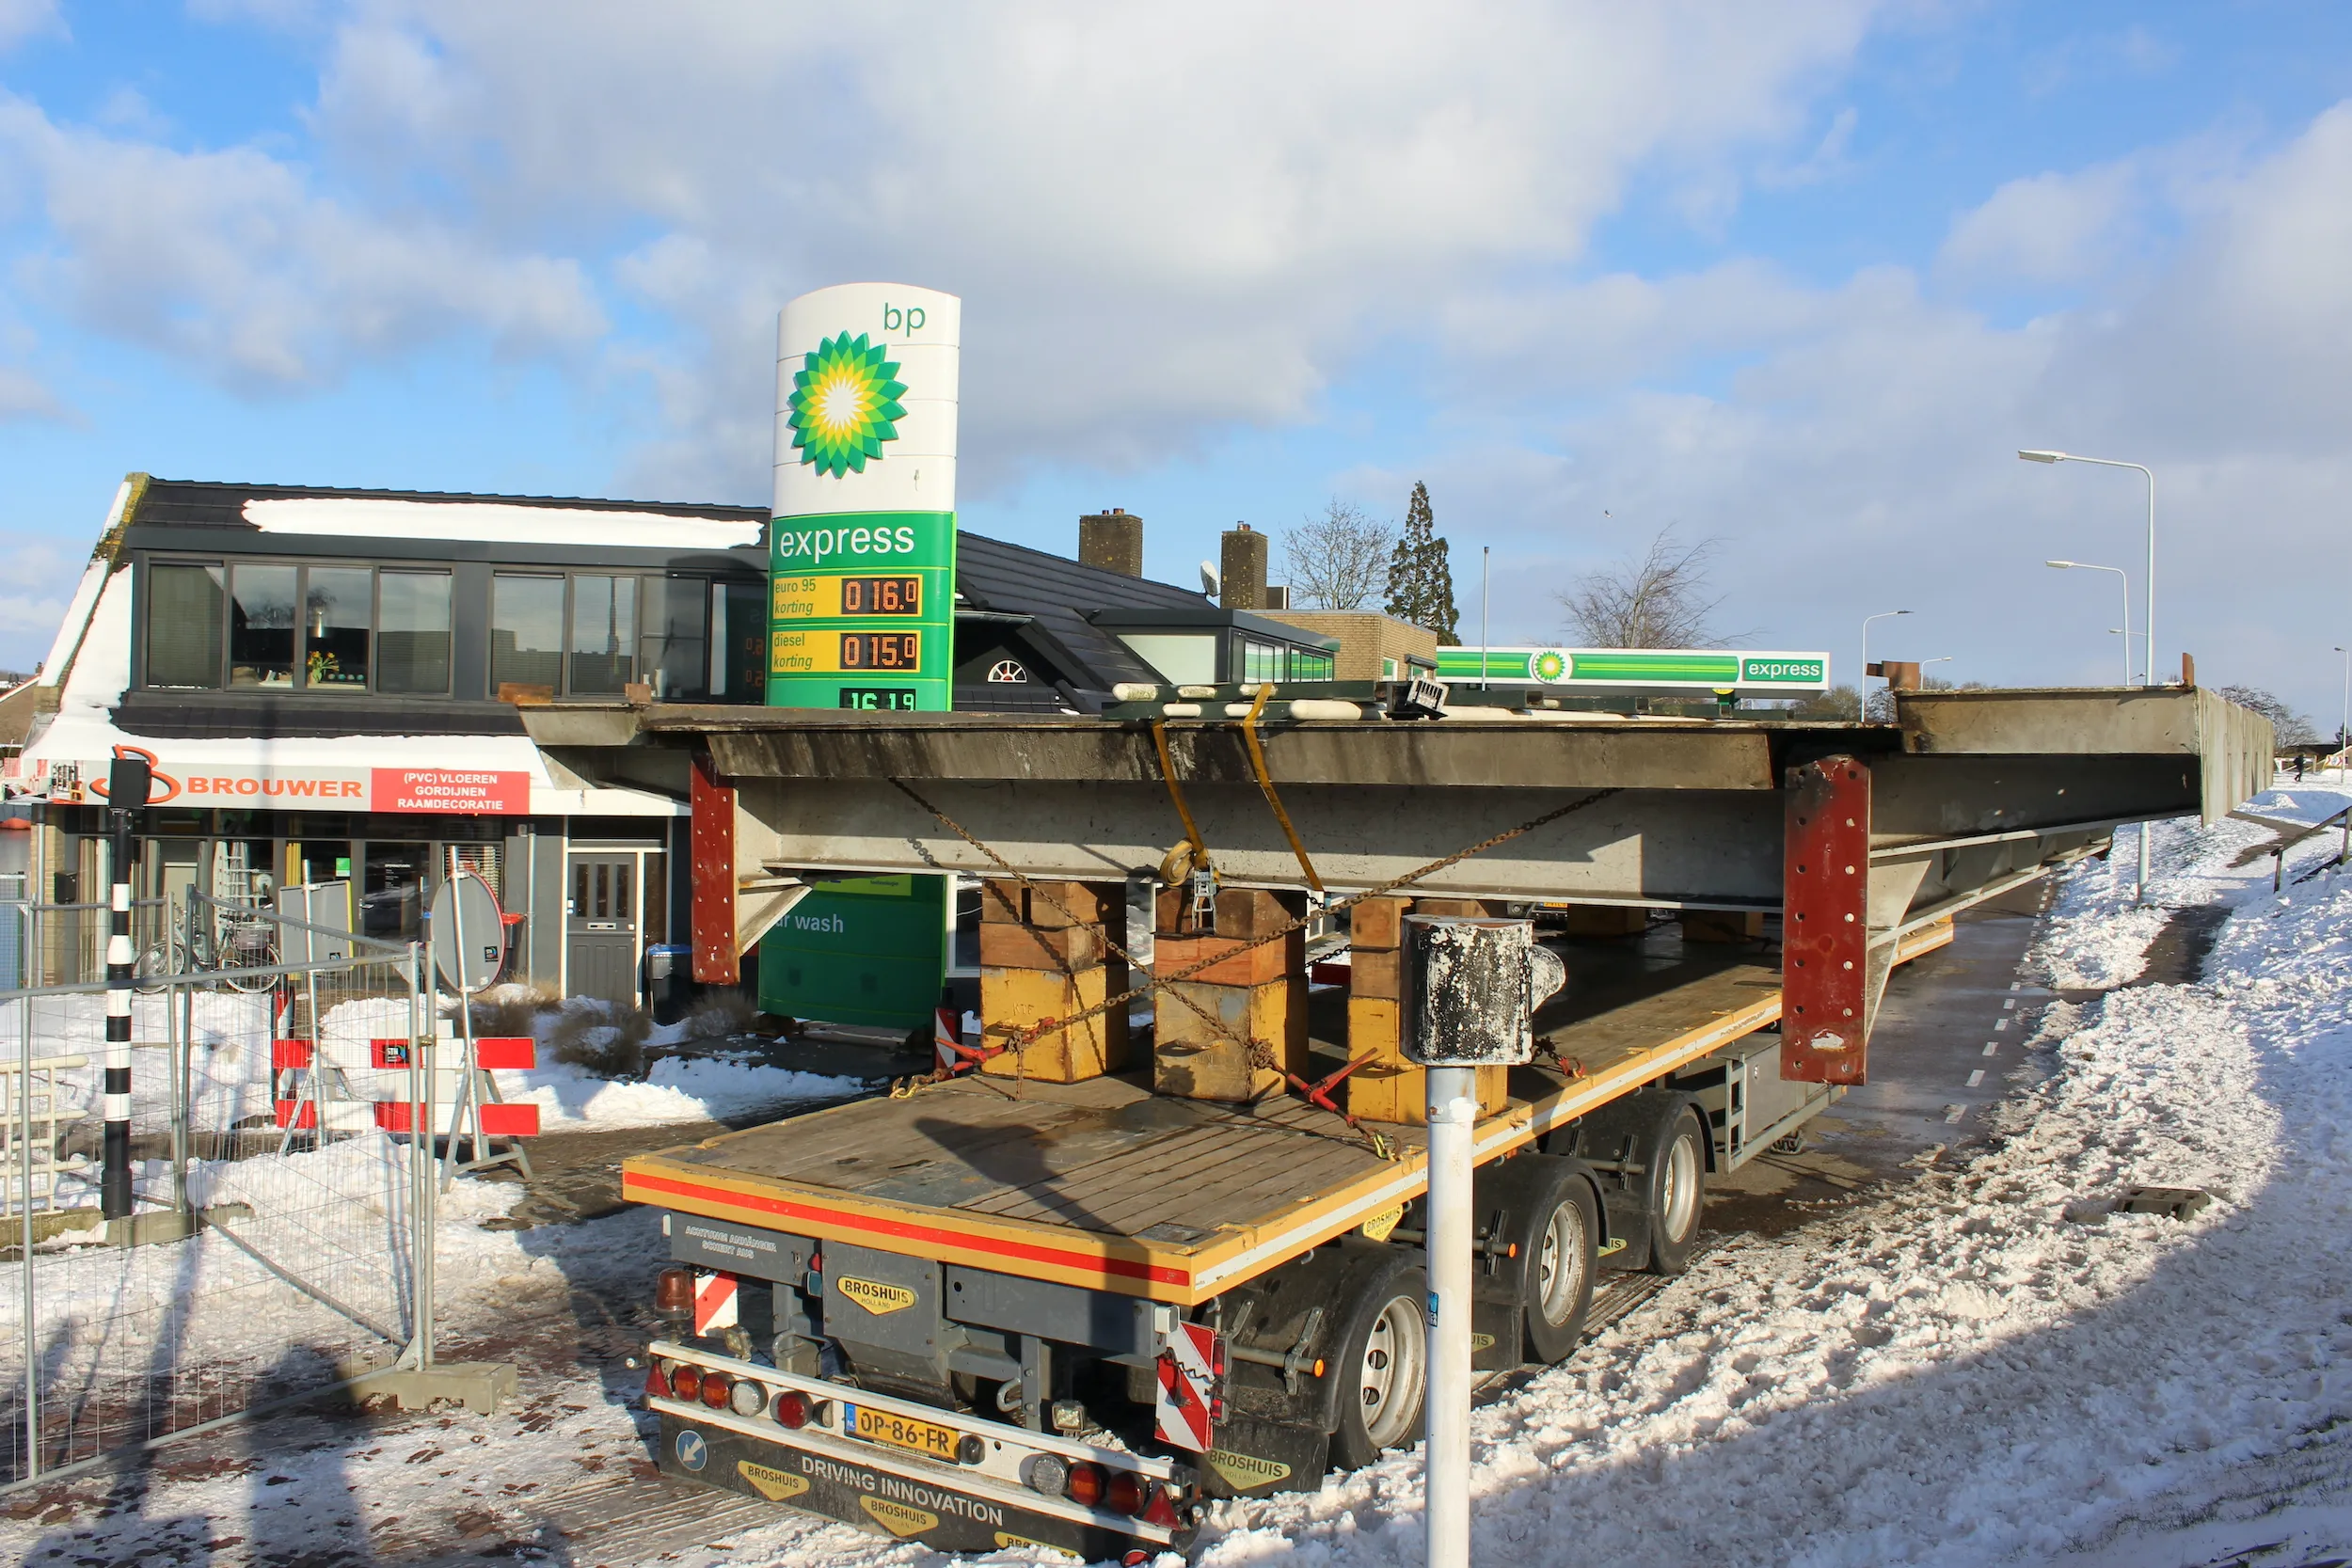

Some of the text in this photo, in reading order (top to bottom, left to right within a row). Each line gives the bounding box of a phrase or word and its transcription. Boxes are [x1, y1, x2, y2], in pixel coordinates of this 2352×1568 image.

[883, 302, 926, 338] bp
[780, 526, 914, 564] express
[775, 578, 816, 594] euro 95
[774, 599, 814, 615] korting
[773, 633, 805, 647] diesel
[773, 654, 813, 670] korting
[1748, 663, 1820, 678] express
[404, 772, 498, 784] (PVC) VLOEREN
[187, 777, 363, 798] BROUWER
[415, 785, 486, 797] GORDIJNEN
[397, 798, 503, 810] RAAMDECORATIE
[794, 913, 844, 933] wash
[845, 1280, 909, 1304] BROSHUIS
[861, 1297, 892, 1308] HOLLAND
[860, 1412, 949, 1453] OP-86-FR
[1209, 1450, 1282, 1477] BROSHUIS
[747, 1465, 800, 1489] BROSHUIS
[1223, 1470, 1259, 1483] HOLLAND
[802, 1455, 1004, 1527] DRIVING INNOVATION
[870, 1500, 927, 1525] BROSHUIS
